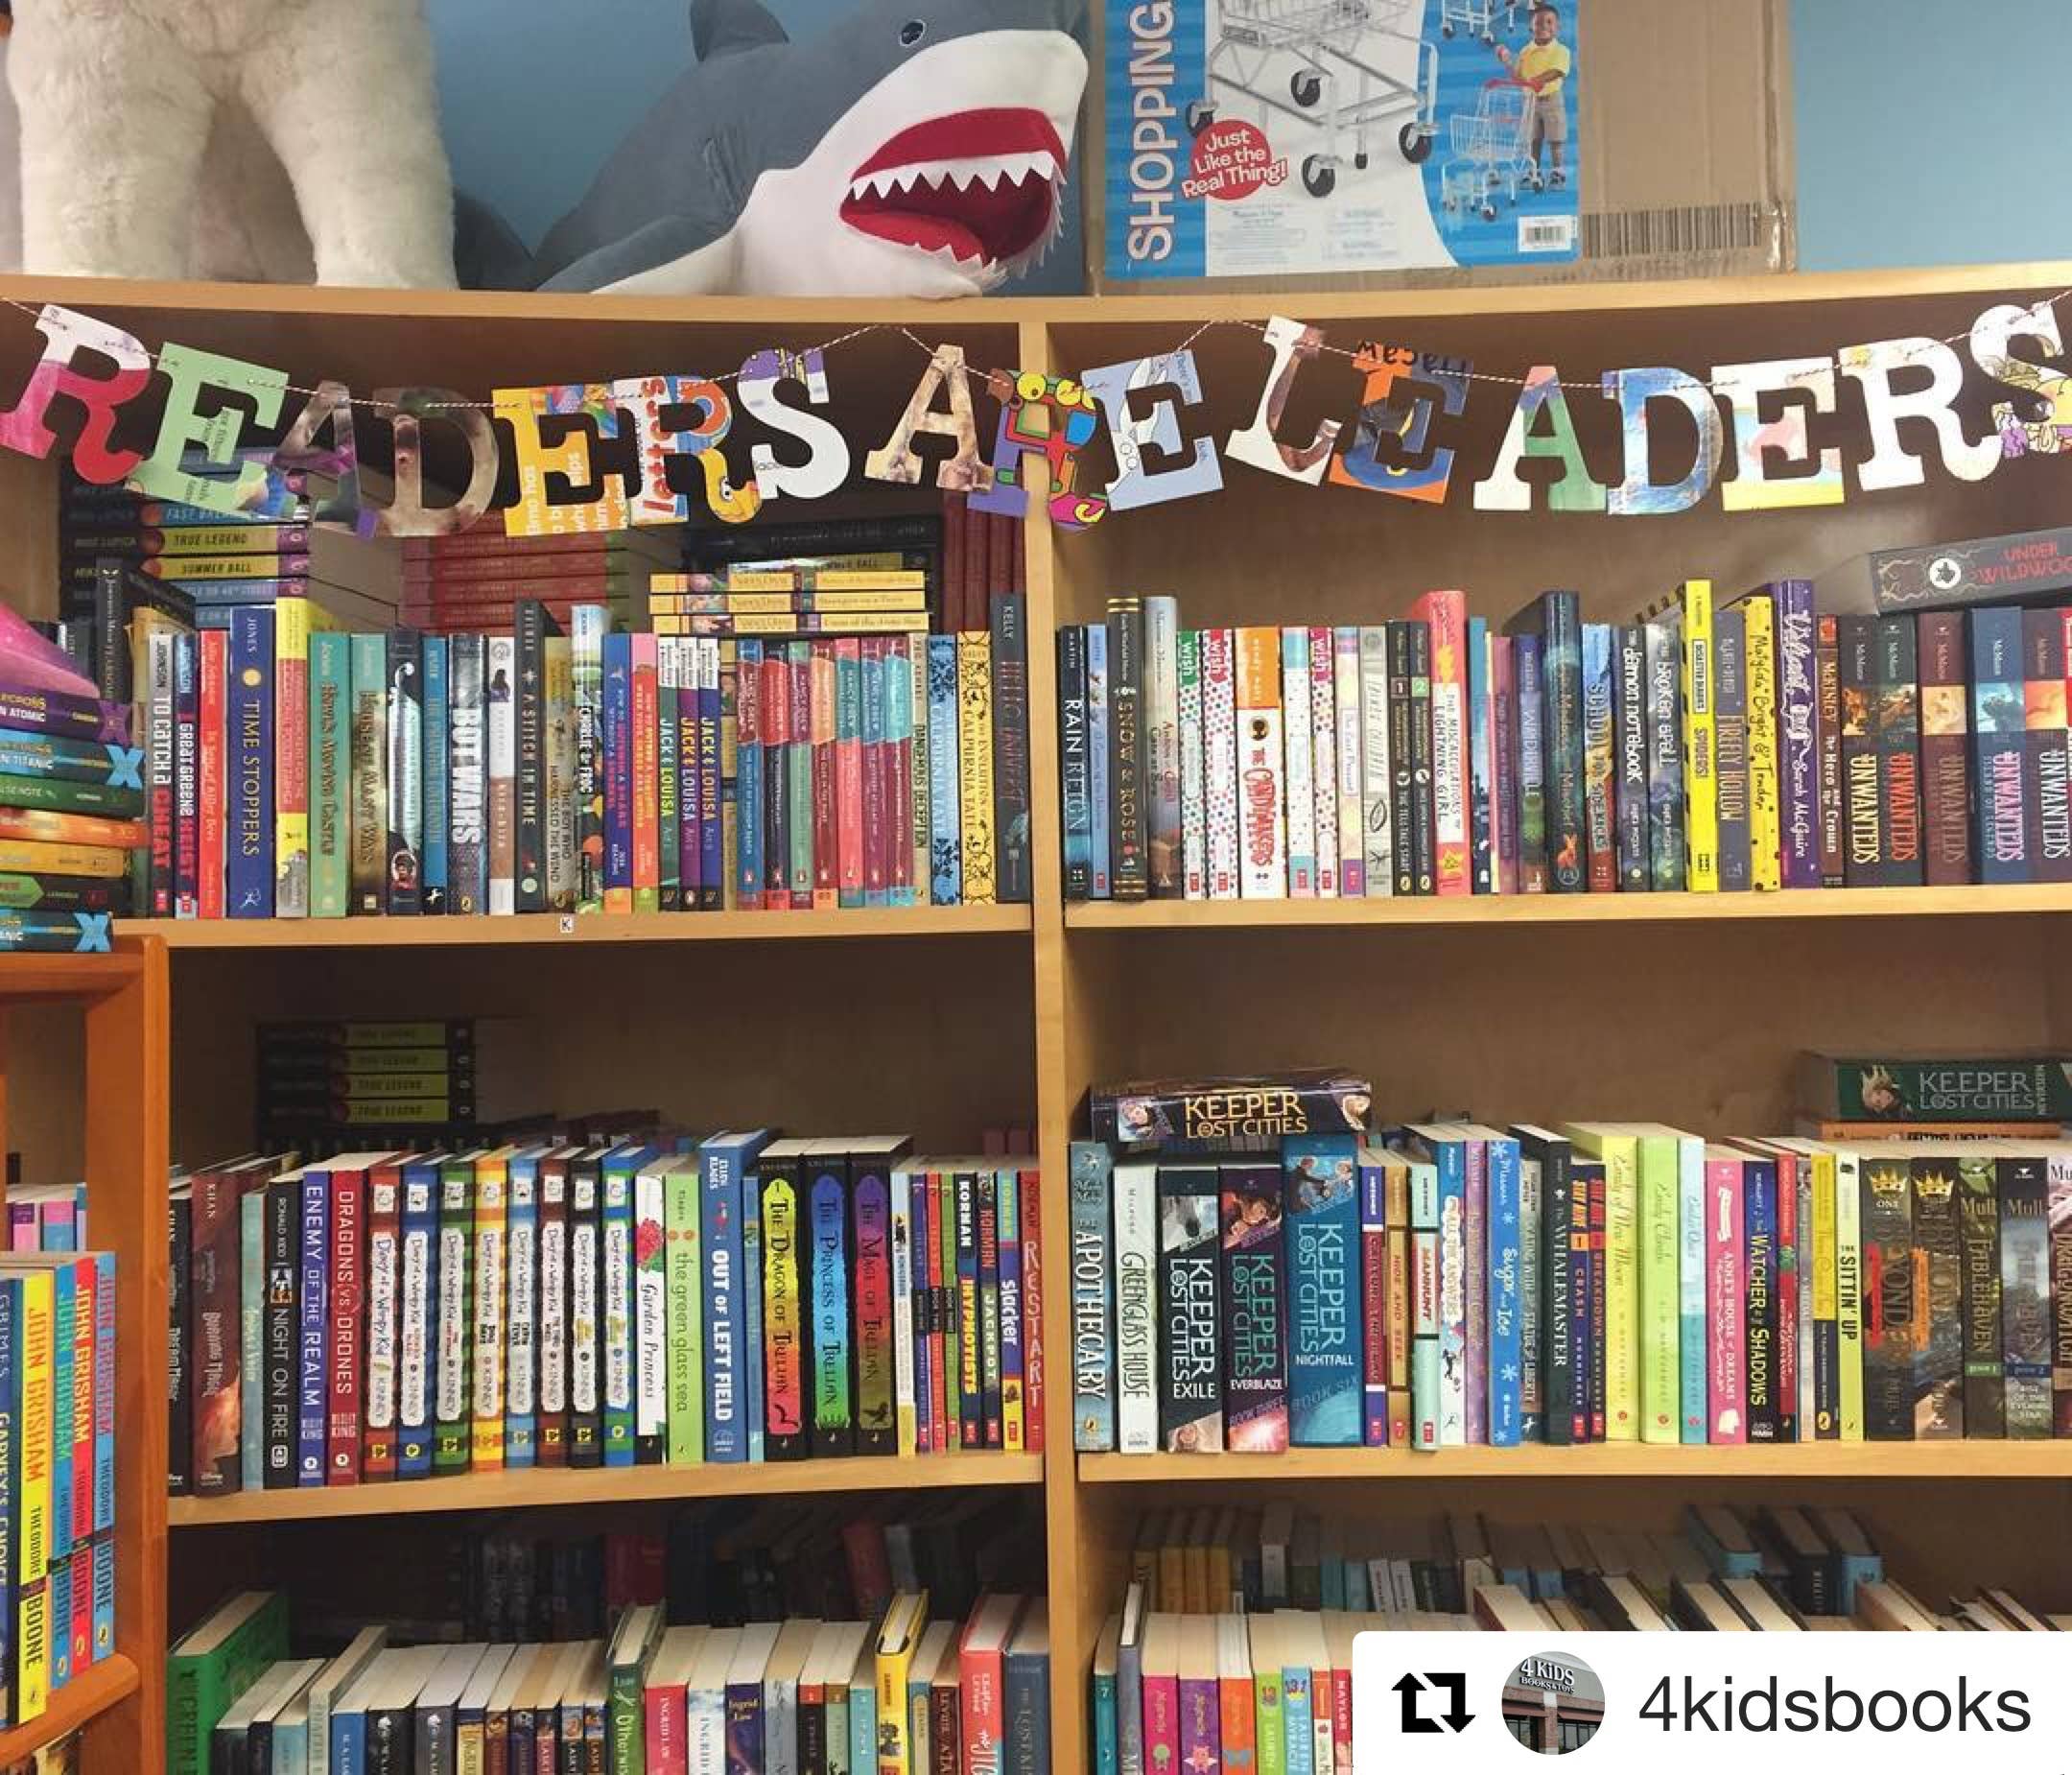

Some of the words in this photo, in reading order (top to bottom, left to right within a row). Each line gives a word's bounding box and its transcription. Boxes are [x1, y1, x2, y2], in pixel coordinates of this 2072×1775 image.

[1127, 0, 1175, 261] SHOPPING
[1206, 129, 1251, 152] Just
[1182, 170, 1224, 199] Real
[1226, 156, 1290, 187] Thing!
[1194, 154, 1232, 173] Like
[1235, 146, 1265, 163] the
[0, 303, 849, 537] READERS
[863, 344, 1224, 533] ARE
[1224, 304, 2072, 515] LEADERS
[174, 535, 200, 546] TRUE
[247, 617, 257, 652] JONES
[1002, 605, 1014, 640] KELLY
[1182, 642, 1196, 675] wish
[1210, 639, 1225, 674] wish
[523, 694, 535, 703] A
[1587, 684, 1606, 750] SCHOOL
[1751, 697, 1771, 738] Bright
[244, 700, 260, 748] TIME
[452, 708, 482, 758] BOT
[523, 710, 535, 760] STITCH
[661, 719, 675, 757] JACK
[682, 718, 695, 756] JACK
[701, 717, 715, 756] JACK
[1065, 699, 1082, 752] RAIN
[1118, 701, 1135, 764] SNOW
[1435, 706, 1446, 778] LIGHTNING
[1719, 715, 1742, 764] FIREFLY
[964, 710, 977, 792] CALPURNIA
[1121, 769, 1133, 781] &
[1825, 753, 1836, 785] Hero
[1067, 762, 1088, 830] REIGN
[1437, 785, 1446, 821] GIRL
[1720, 769, 1744, 820] HOLLOW
[1792, 760, 1807, 796] Sarah
[153, 790, 170, 867] CHEAT
[244, 756, 260, 856] STOPPERS
[452, 766, 482, 843] WARS
[523, 792, 535, 825] TIME
[914, 790, 926, 848] DECEPTION
[964, 796, 977, 830] TATE
[1119, 788, 1136, 840] ROSE
[1789, 801, 1808, 858] McGuire
[1850, 754, 1877, 863] UNWANTEDS
[1889, 753, 1917, 861] UNWANTEDS
[1939, 755, 1966, 863] UNWANTEDS
[1993, 751, 2023, 861] UNWANTEDS
[2039, 750, 2069, 859] UNWANTEDS
[561, 835, 572, 860] WHO
[1825, 810, 1837, 853] Crown
[1185, 1092, 1306, 1120] KEEPER
[1919, 1072, 2030, 1093] KEEPER
[1919, 1093, 1966, 1110] LOST
[1972, 1093, 2035, 1110] CITIES
[1186, 1121, 1236, 1138] LOST
[1242, 1117, 1307, 1137] CITIES
[206, 1183, 216, 1219] KHAN
[306, 1186, 322, 1259] ENEMY
[771, 1198, 789, 1225] THE
[819, 1199, 837, 1225] THE
[958, 1181, 971, 1246] KORMAN
[337, 1191, 353, 1283] DRAGONS
[980, 1209, 995, 1268] KORMAN
[1297, 1223, 1318, 1278] LOST
[308, 1269, 319, 1287] OF
[674, 1252, 693, 1280] the
[713, 1250, 729, 1290] OUT
[772, 1235, 790, 1299] DRAGON
[820, 1235, 838, 1310] PRINCESS
[1169, 1258, 1188, 1310] LOST
[1233, 1255, 1251, 1307] LOST
[1318, 1223, 1346, 1348] KEEPER
[1495, 1247, 1519, 1294] Sugar
[1750, 1234, 1769, 1310] WATCHER
[1840, 1256, 1856, 1314] SITTIN'
[76, 1284, 91, 1341] JOHN
[307, 1294, 319, 1322] THE
[641, 1283, 657, 1334] Garden
[667, 1285, 692, 1332] green
[715, 1295, 727, 1314] OF
[774, 1305, 786, 1321] OF
[1001, 1279, 1017, 1346] slacker
[1075, 1230, 1105, 1398] APOTHECARY
[1120, 1252, 1149, 1344] GREENGLASS
[1251, 1255, 1276, 1375] KEEPER
[1553, 1224, 1567, 1367] WHALEMASTER
[1575, 1267, 1585, 1317] CRASH
[1969, 1238, 1993, 1353] FABLEHAVEN
[28, 1308, 47, 1369] JOHN
[273, 1308, 288, 1361] NIGHT
[822, 1315, 835, 1334] OF
[983, 1294, 996, 1381] JACKPOT
[1189, 1258, 1215, 1378] KEEPER
[1299, 1284, 1319, 1354] CITIES
[1497, 1309, 1512, 1337] Ice
[1726, 1298, 1734, 1337] HOUSE
[1842, 1320, 1857, 1339] UP
[337, 1317, 352, 1395] DRONES
[667, 1337, 694, 1379] glass
[713, 1321, 730, 1367] LEFT
[1171, 1315, 1189, 1381] CITIES
[1234, 1313, 1251, 1377] CITIES
[1296, 1354, 1355, 1367] NIGHTFALL
[1750, 1328, 1768, 1405] SHADOWS
[74, 1347, 90, 1442] GRISHAM
[273, 1368, 288, 1396] ON
[305, 1332, 320, 1407] REALM
[644, 1341, 658, 1398] Princess
[1123, 1352, 1150, 1398] HOUSE
[1173, 1382, 1215, 1399] EXILE
[1726, 1352, 1735, 1400] DREAMS
[273, 1404, 288, 1437] FIRE
[675, 1384, 689, 1412] sea
[715, 1373, 732, 1420] FIELD
[26, 1381, 48, 1482] GRISHAM
[95, 1543, 112, 1613] BOONE
[26, 1598, 42, 1670] BOONE
